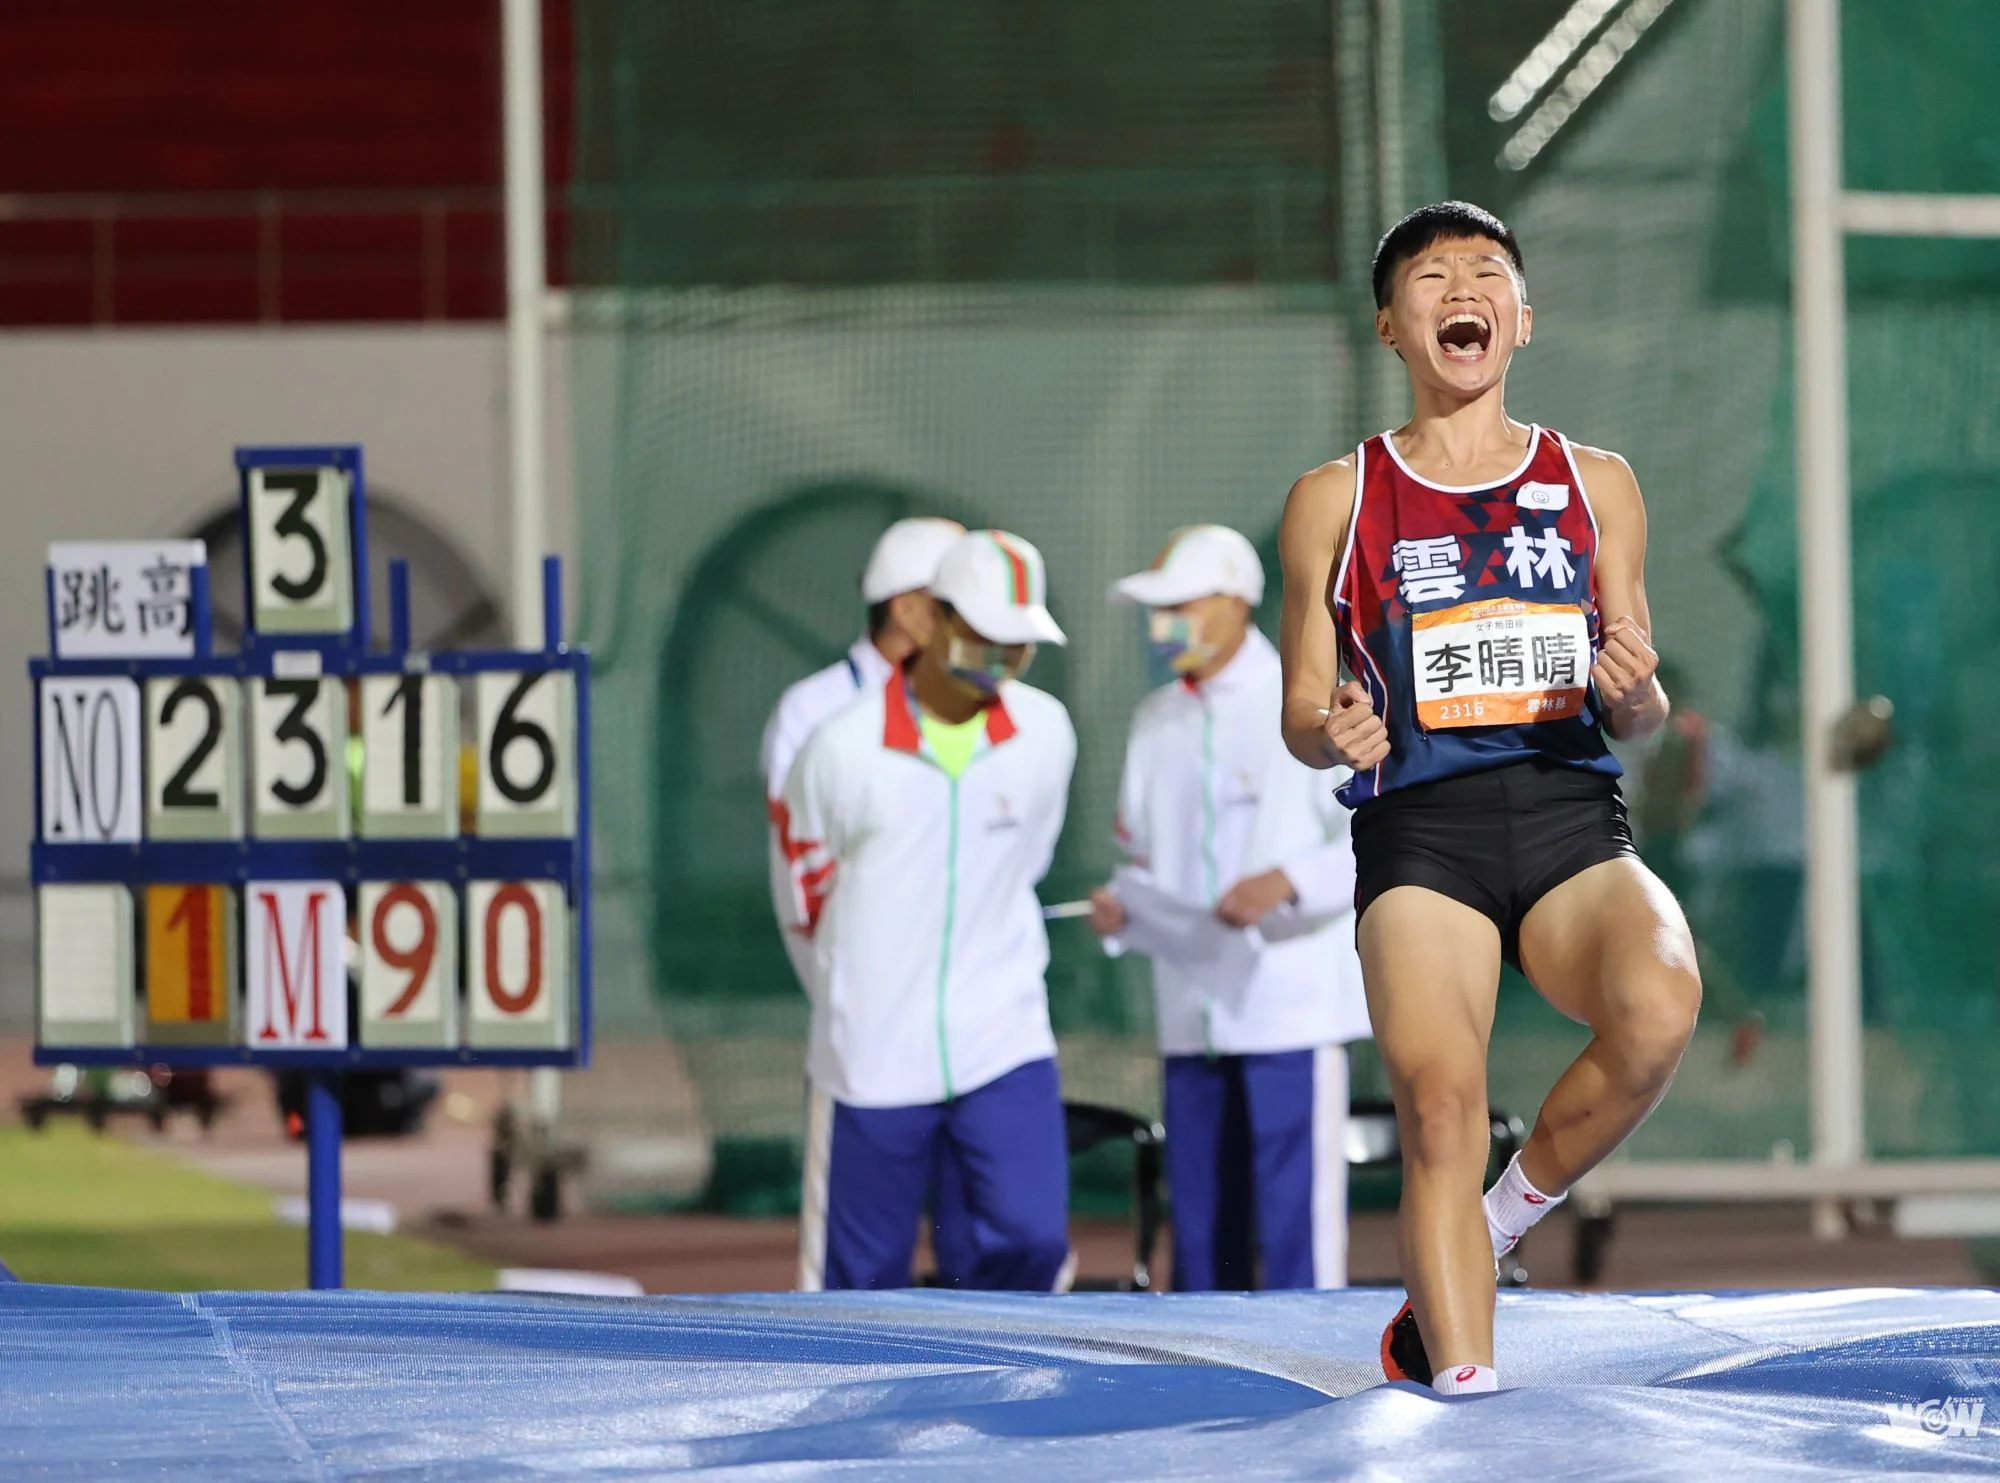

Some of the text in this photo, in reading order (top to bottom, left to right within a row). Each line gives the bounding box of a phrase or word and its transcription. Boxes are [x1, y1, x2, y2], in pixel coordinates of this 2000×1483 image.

[262, 473, 328, 603] 3
[1392, 526, 1577, 603] 雲林
[60, 554, 192, 638] 跳高
[1424, 632, 1577, 693] 李晴晴
[1439, 701, 1484, 721] 2316
[51, 690, 123, 841] NO
